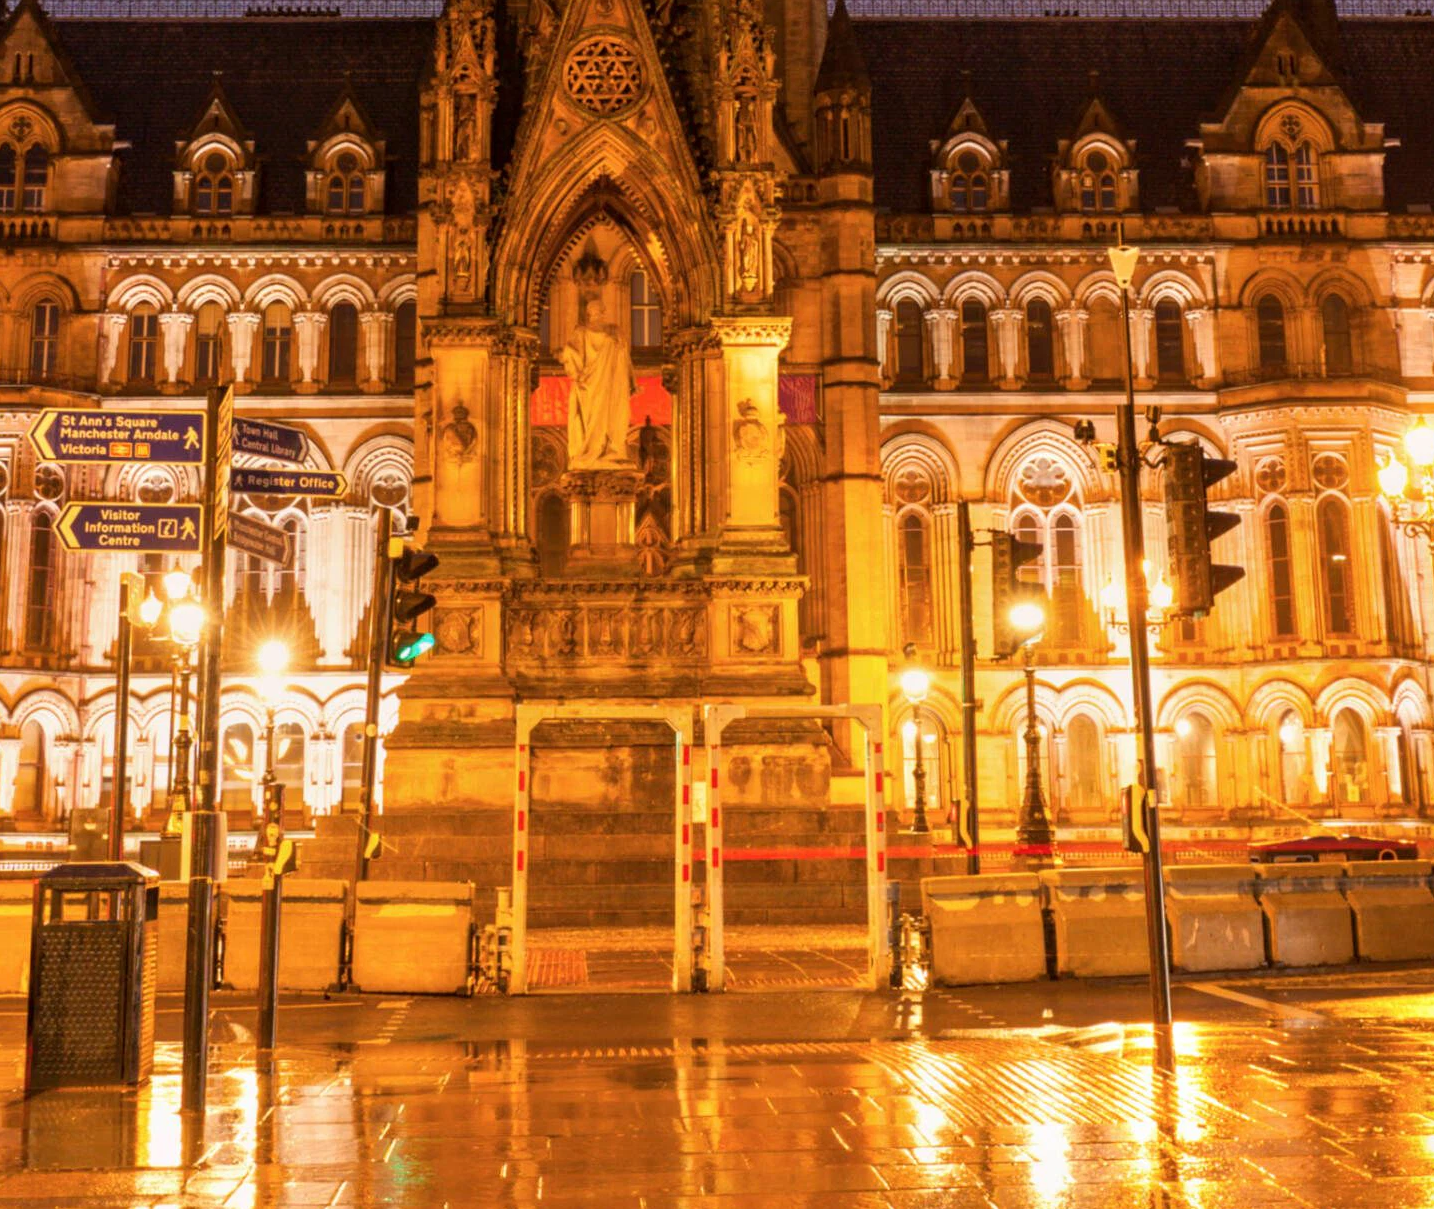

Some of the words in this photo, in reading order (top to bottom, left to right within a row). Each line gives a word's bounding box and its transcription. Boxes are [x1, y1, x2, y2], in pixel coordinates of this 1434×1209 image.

[61, 415, 76, 427] St
[79, 415, 113, 428] Ann's
[116, 416, 159, 429] Square
[60, 427, 131, 440] Manchester
[133, 428, 180, 441] Arndale
[242, 423, 261, 436] Town
[263, 429, 279, 441] Hall
[60, 443, 107, 456] Victoria
[241, 437, 270, 453] Central
[271, 443, 296, 459] Library
[247, 475, 296, 489] Register
[299, 476, 335, 489] Office
[100, 509, 141, 521] Visitor
[84, 521, 155, 534] Information
[98, 534, 141, 546] Centre
